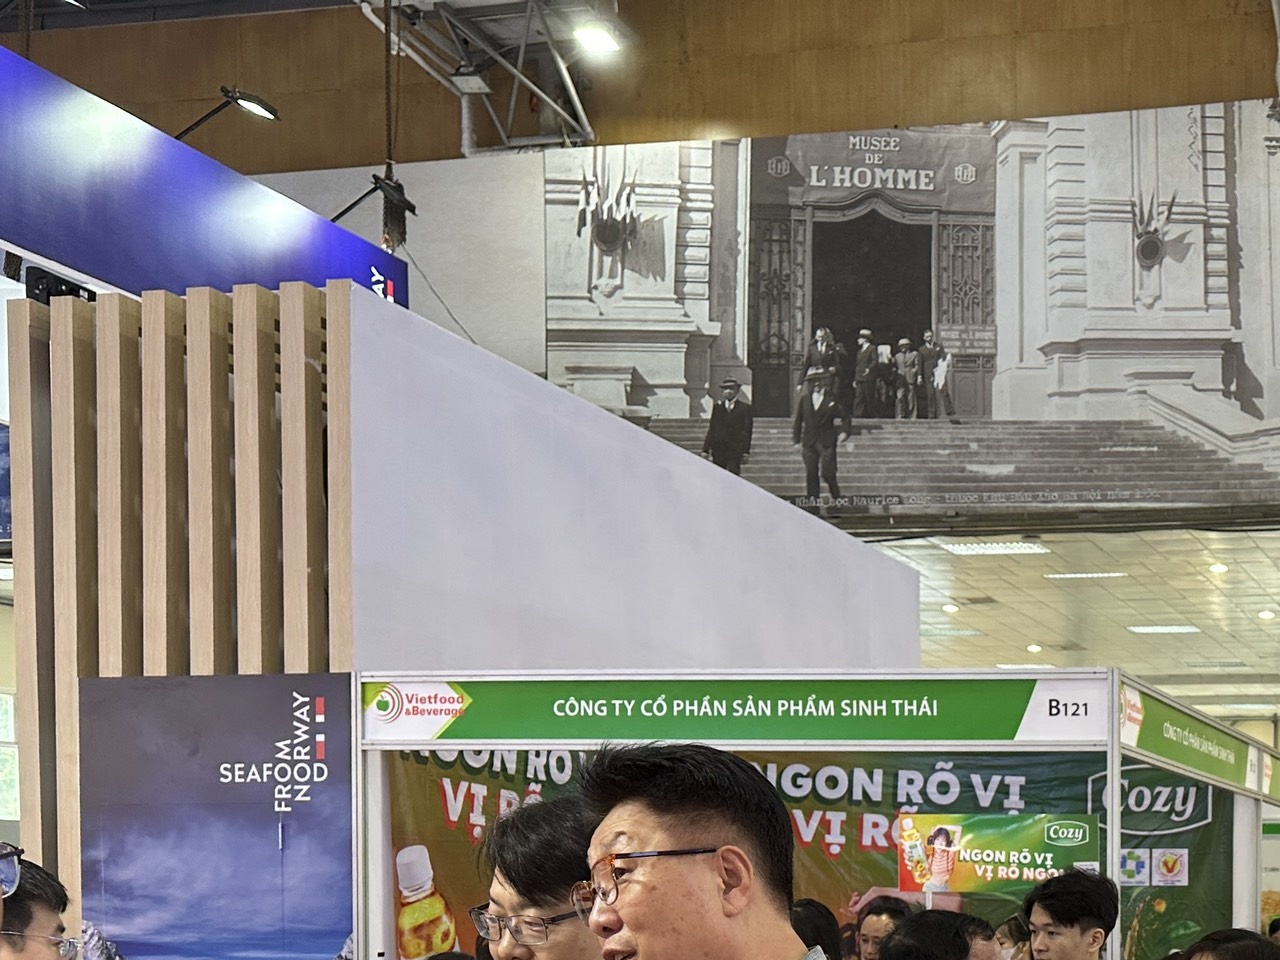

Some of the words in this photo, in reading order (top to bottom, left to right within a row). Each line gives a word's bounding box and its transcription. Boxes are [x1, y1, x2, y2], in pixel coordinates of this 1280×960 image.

[864, 154, 883, 164] DE
[809, 166, 935, 190] L'HOMME
[405, 693, 464, 704] Vietfood
[553, 696, 607, 717] CÔNG
[611, 699, 635, 716] TY
[640, 694, 668, 717] CỔ
[673, 695, 727, 717] PHẦN
[732, 695, 773, 717] SẢN
[778, 694, 835, 717] PHẨM
[841, 699, 887, 716] SINH
[891, 695, 938, 716] THÁI
[1048, 698, 1090, 717] B121
[292, 691, 311, 801] NORWAY
[220, 763, 328, 782] SEAFOOD
[274, 739, 292, 812] FROM
[897, 761, 961, 805] RÕ
[970, 774, 1026, 815] VỊ
[792, 809, 847, 855] VỊ
[1049, 824, 1084, 844] Cozy
[960, 849, 1006, 863] NGON
[1009, 848, 1031, 864] RÕ
[1034, 853, 1054, 868] VỊ
[974, 864, 993, 881] VỊ
[998, 863, 1020, 879] RÕ
[1023, 867, 1064, 881] NGO
